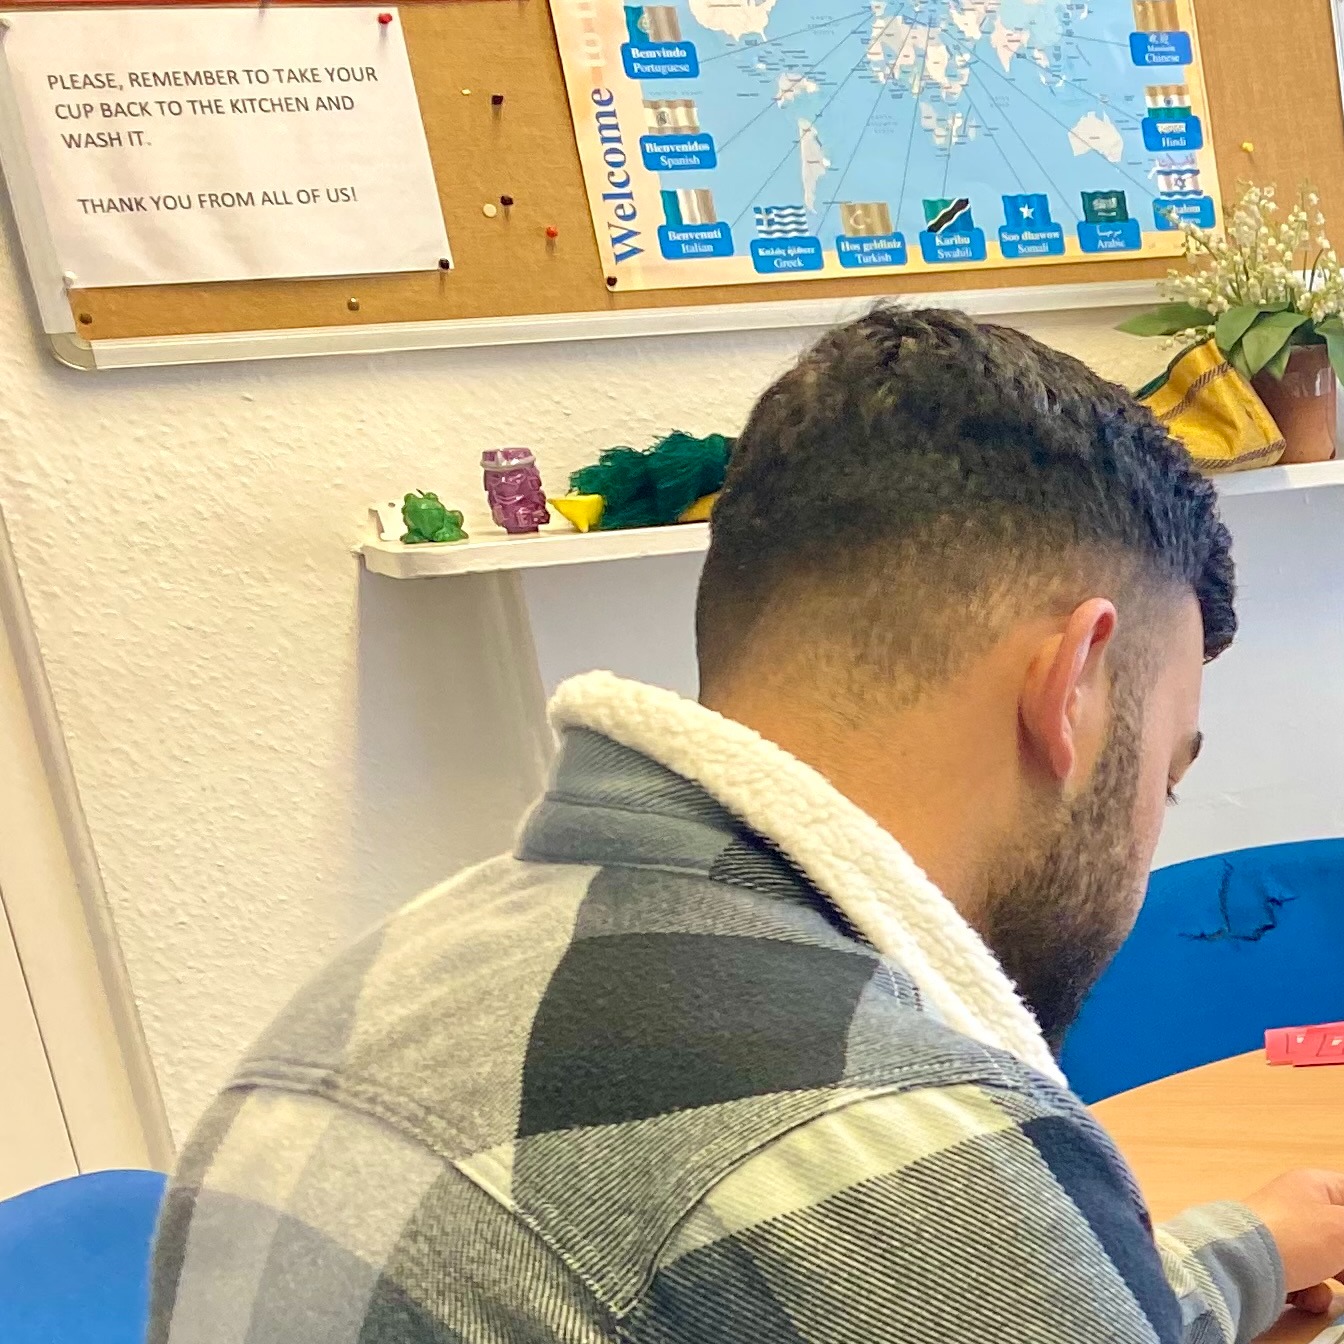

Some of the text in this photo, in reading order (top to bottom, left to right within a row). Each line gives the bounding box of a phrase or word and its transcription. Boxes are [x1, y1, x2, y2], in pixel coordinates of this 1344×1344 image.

[633, 63, 690, 75] Portuguese
[47, 66, 378, 91] PLEASE, REMEMBER TO TAKE YOUR
[55, 96, 355, 120] CUP BACK TO THE KITCHEN AND
[61, 131, 152, 149] WASH IT.
[1161, 137, 1187, 147] Hindi
[645, 141, 710, 153] Bienvenidos
[660, 155, 700, 168] Spanish
[591, 88, 644, 265] Welcome
[78, 187, 357, 214] THANK YOU FROM ALL OF US!
[668, 229, 721, 241] Benvenuti
[682, 242, 713, 253] Italian
[1018, 242, 1049, 253] Somali
[1097, 239, 1126, 249] Arabic
[855, 253, 892, 264] Turkish
[938, 247, 972, 259] Swahili
[774, 258, 804, 268] Greek
